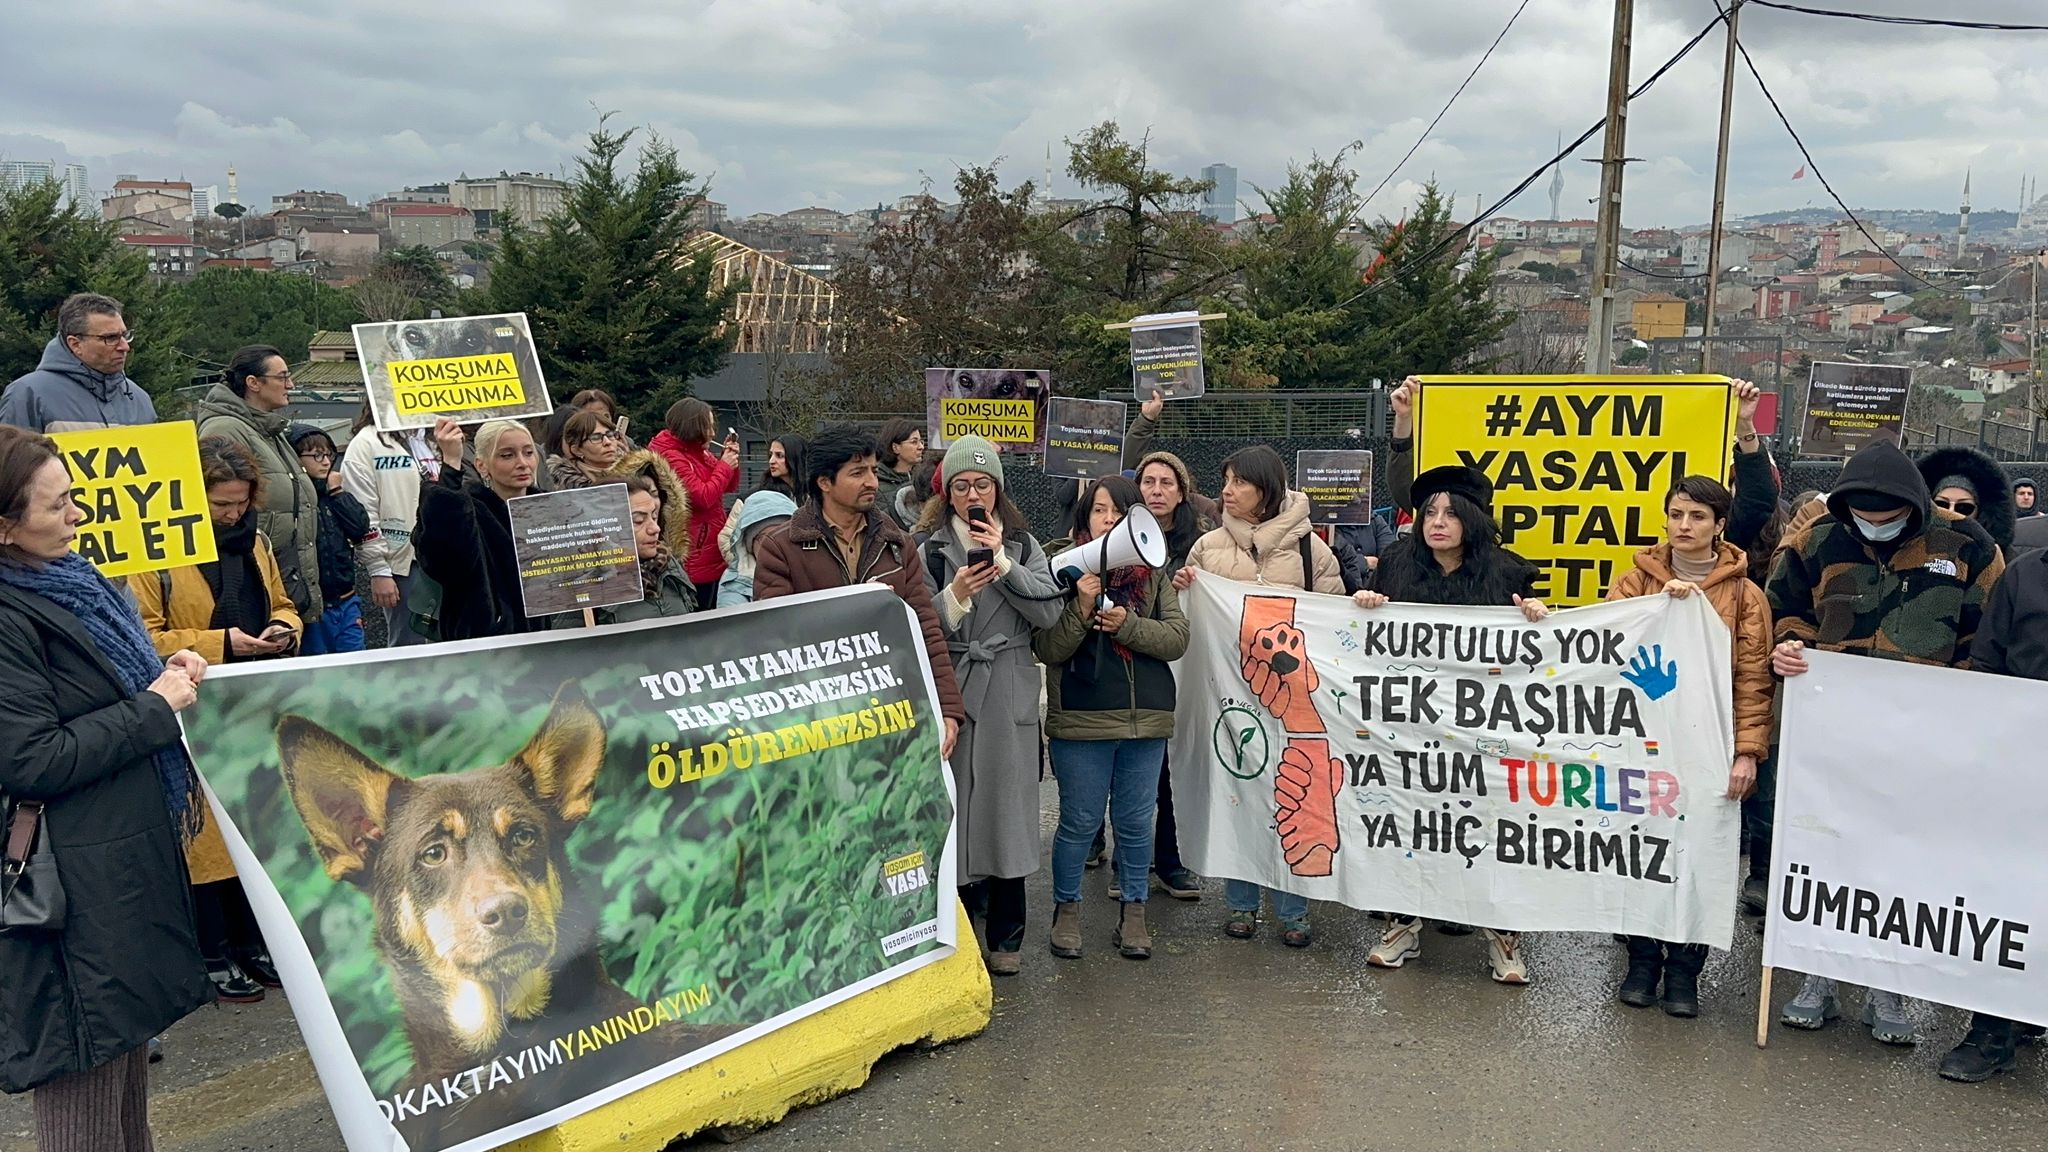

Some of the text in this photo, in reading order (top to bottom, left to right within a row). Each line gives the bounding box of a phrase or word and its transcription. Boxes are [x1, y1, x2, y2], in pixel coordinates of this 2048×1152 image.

[395, 358, 510, 383] KOMŞUMA
[401, 384, 517, 410] DOKUNMA
[1814, 381, 1837, 390] Ülkede
[945, 402, 1029, 420] KOMŞUMA
[1485, 394, 1663, 437] #AYM
[1810, 409, 1834, 417] ORTAK
[1835, 411, 1864, 419] OLMAYA
[1865, 413, 1890, 421] DEVAM
[1829, 419, 1879, 428] EDECEKSİNİZ?
[946, 423, 1029, 438] DOKUNMA
[1060, 425, 1092, 434] Toplumun
[1050, 439, 1119, 452] BU YASAYA KARŞI!
[373, 455, 413, 471] TAKE
[1456, 450, 1687, 491] YASAYI
[141, 514, 203, 560] ET
[526, 525, 622, 544] hakkını vermek hukukun hangi
[527, 517, 618, 536] Belediyelere sınırsız öldürme
[1489, 505, 1658, 546] PTAL
[541, 536, 610, 551] maddesiyle uyuşuyor?
[521, 567, 552, 578] SİSTEME
[553, 565, 575, 573] ORTAK
[586, 555, 636, 568] OLACAKSINIZ?
[531, 547, 624, 567] ANAYASAYI TANIMAYAN BU
[1923, 562, 1946, 570] NORTH
[1525, 558, 1612, 598] ET!
[1364, 620, 1626, 674] KURTULUŞ YOK
[639, 630, 890, 701] TOPLAYAMAZSIN.
[666, 661, 904, 731] HAPSEDEMEZSİN.
[1220, 697, 1262, 717] GO VEGAN
[1353, 675, 1648, 748] TEK BAŞINA
[648, 697, 917, 790] ÖLDÜREMEZSİN!
[1345, 740, 1681, 818] YA TÜM TÜRLER
[1360, 802, 1679, 884] YA HİÇ BİRİMİZ
[886, 866, 929, 897] YASA
[1782, 862, 2030, 971] ÜMRANİYE
